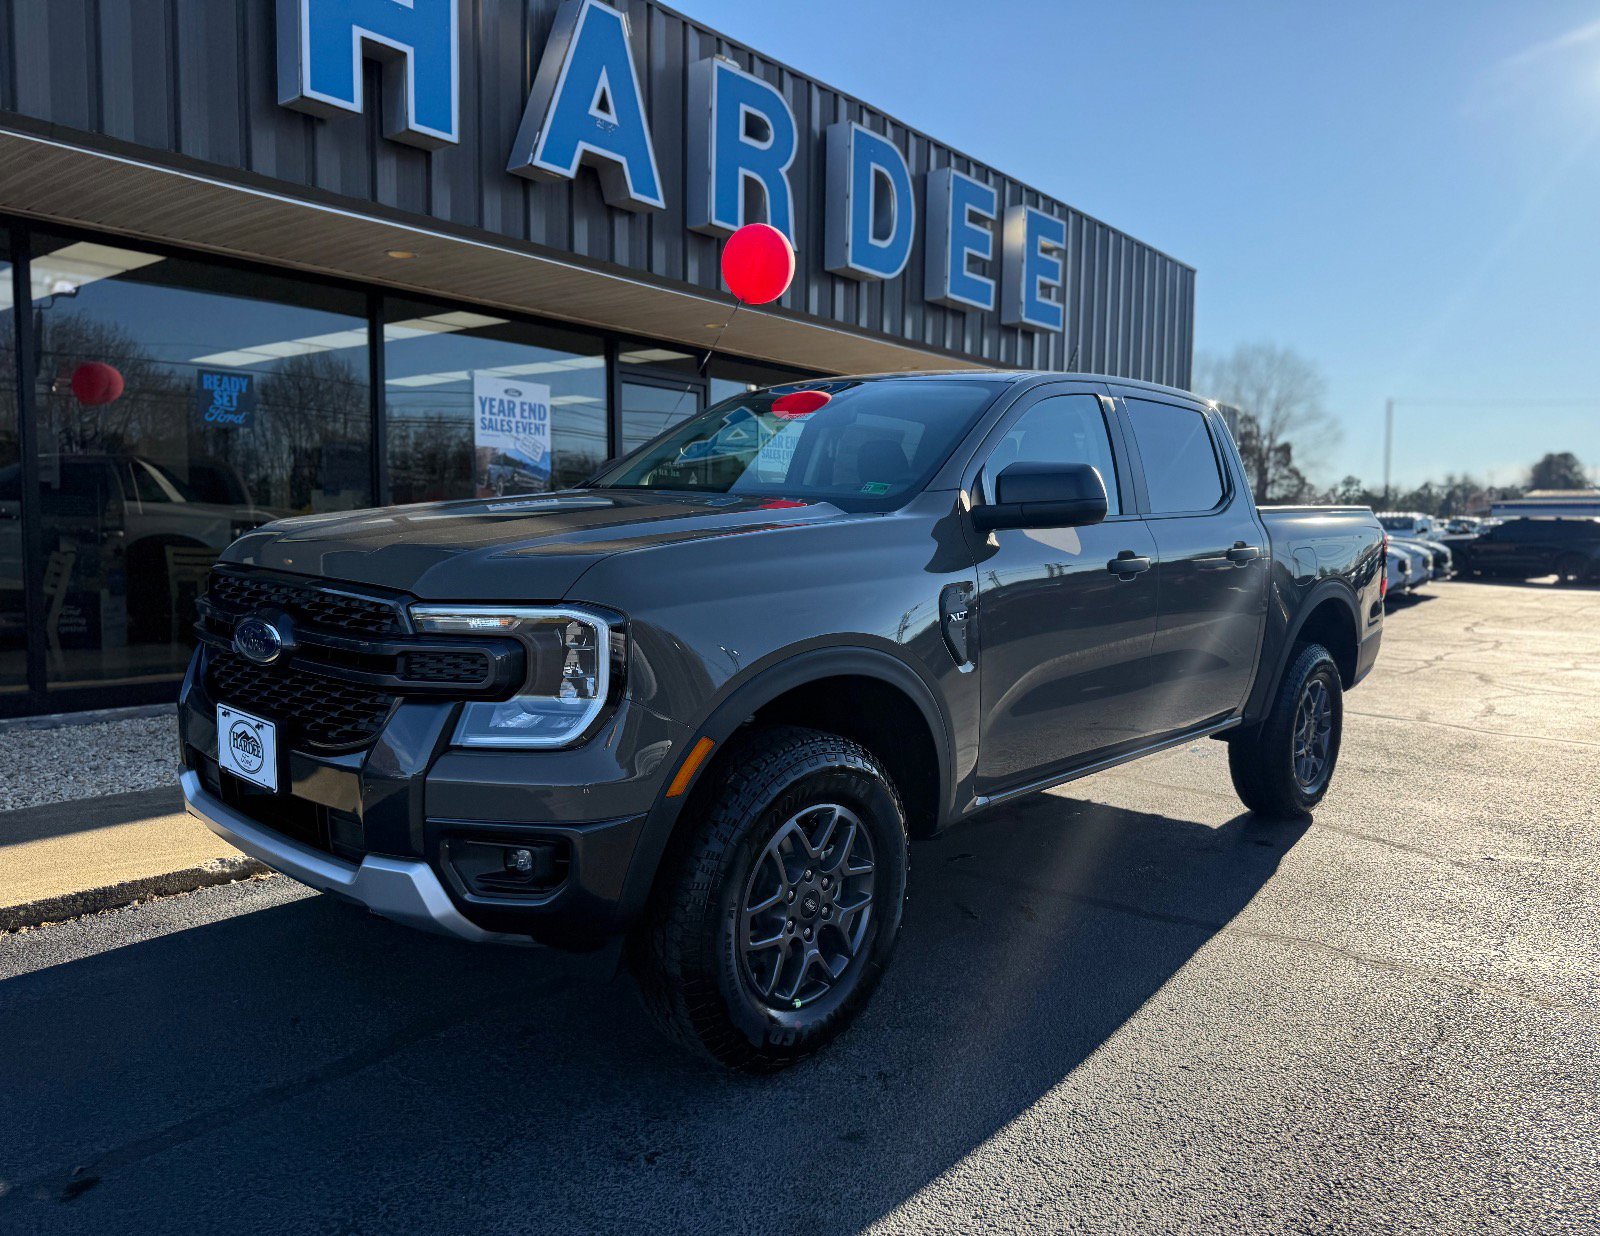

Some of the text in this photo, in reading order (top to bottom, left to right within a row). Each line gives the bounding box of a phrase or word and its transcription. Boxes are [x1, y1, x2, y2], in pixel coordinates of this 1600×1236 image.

[300, 0, 1067, 332] HARDEE
[203, 373, 248, 393] READY
[213, 390, 239, 406] SET
[204, 405, 249, 424] Ford
[478, 396, 547, 422] YEAR END
[480, 417, 547, 437] SALES EVENT
[949, 610, 968, 623] XLT
[232, 730, 262, 759] HARDEE
